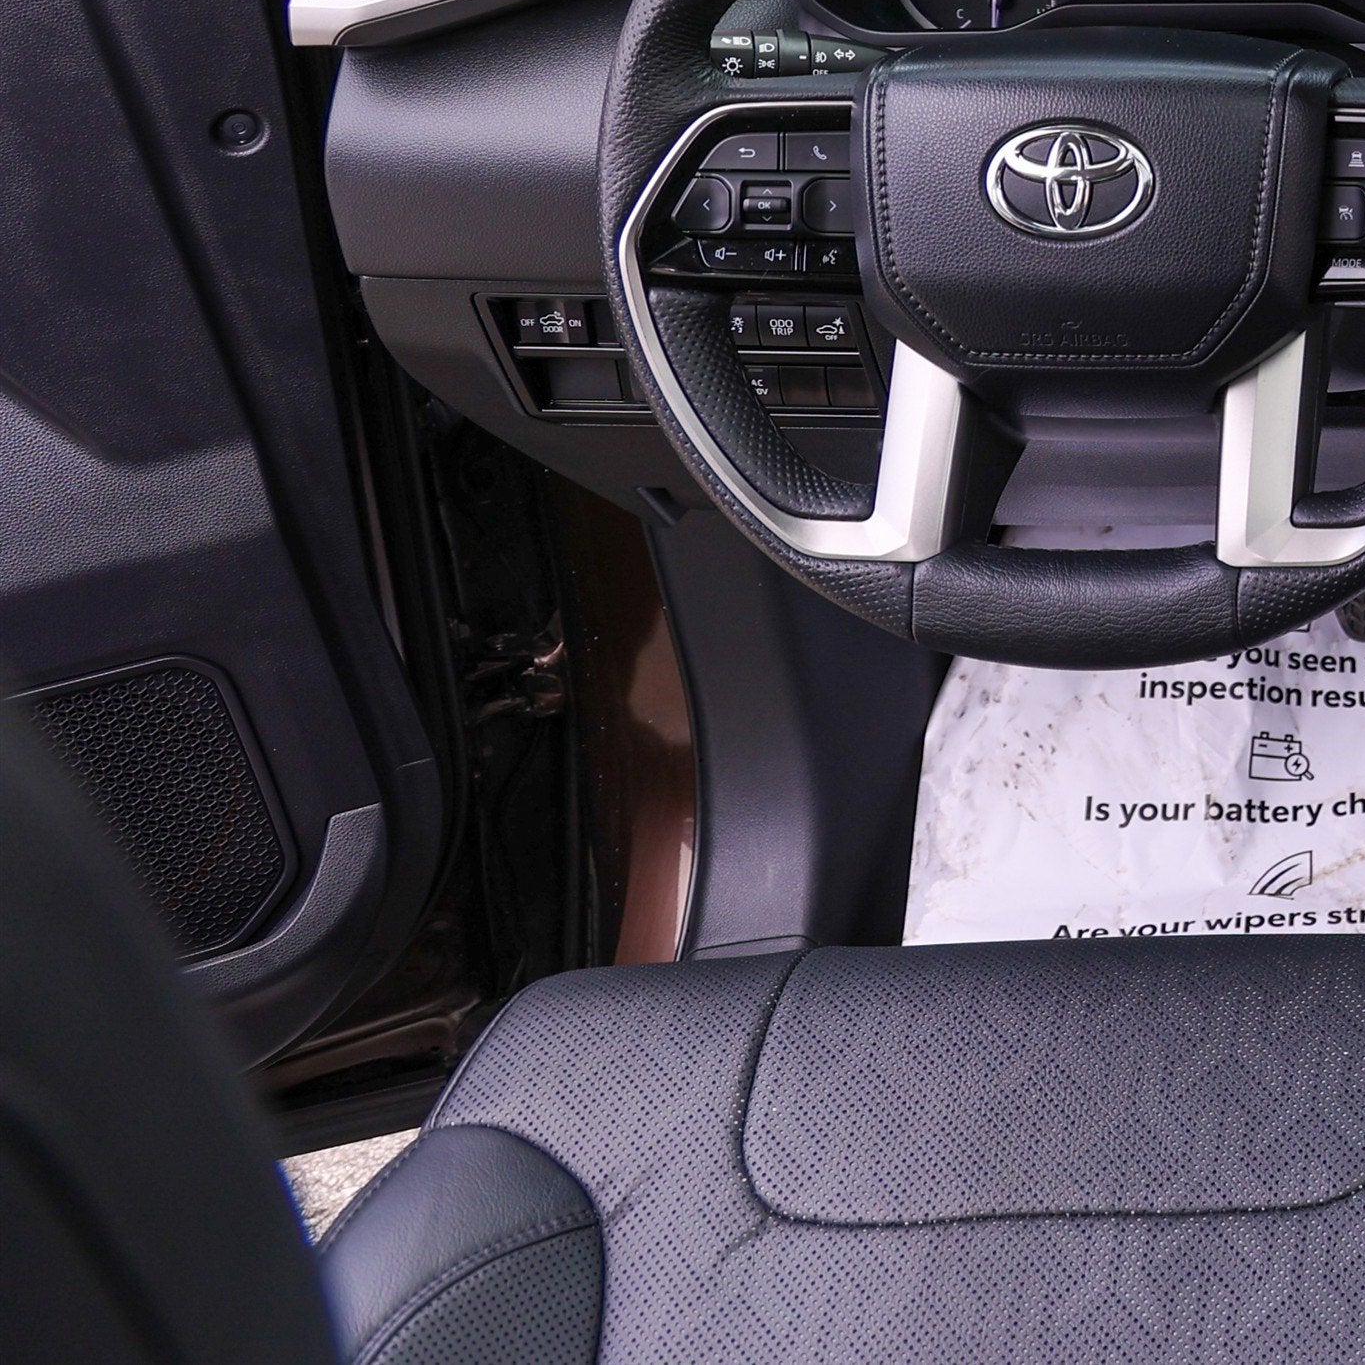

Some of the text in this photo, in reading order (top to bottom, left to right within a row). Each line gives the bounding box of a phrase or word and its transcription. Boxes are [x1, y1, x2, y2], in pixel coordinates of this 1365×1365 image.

[956, 8, 964, 19] C
[757, 201, 771, 210] OK
[1331, 258, 1362, 268] MODE
[520, 318, 582, 327] OFF ON
[769, 319, 794, 328] ODO
[542, 325, 564, 333] DOOR
[770, 327, 794, 336] TRIP
[1226, 647, 1279, 669] you
[1287, 649, 1357, 673] seen
[1138, 672, 1302, 707] inspection
[1084, 795, 1110, 822] Is
[1118, 799, 1195, 829] your
[1203, 793, 1323, 827] battery
[1053, 924, 1109, 939] Are
[1118, 919, 1197, 937] your
[1203, 906, 1318, 933] wipers
